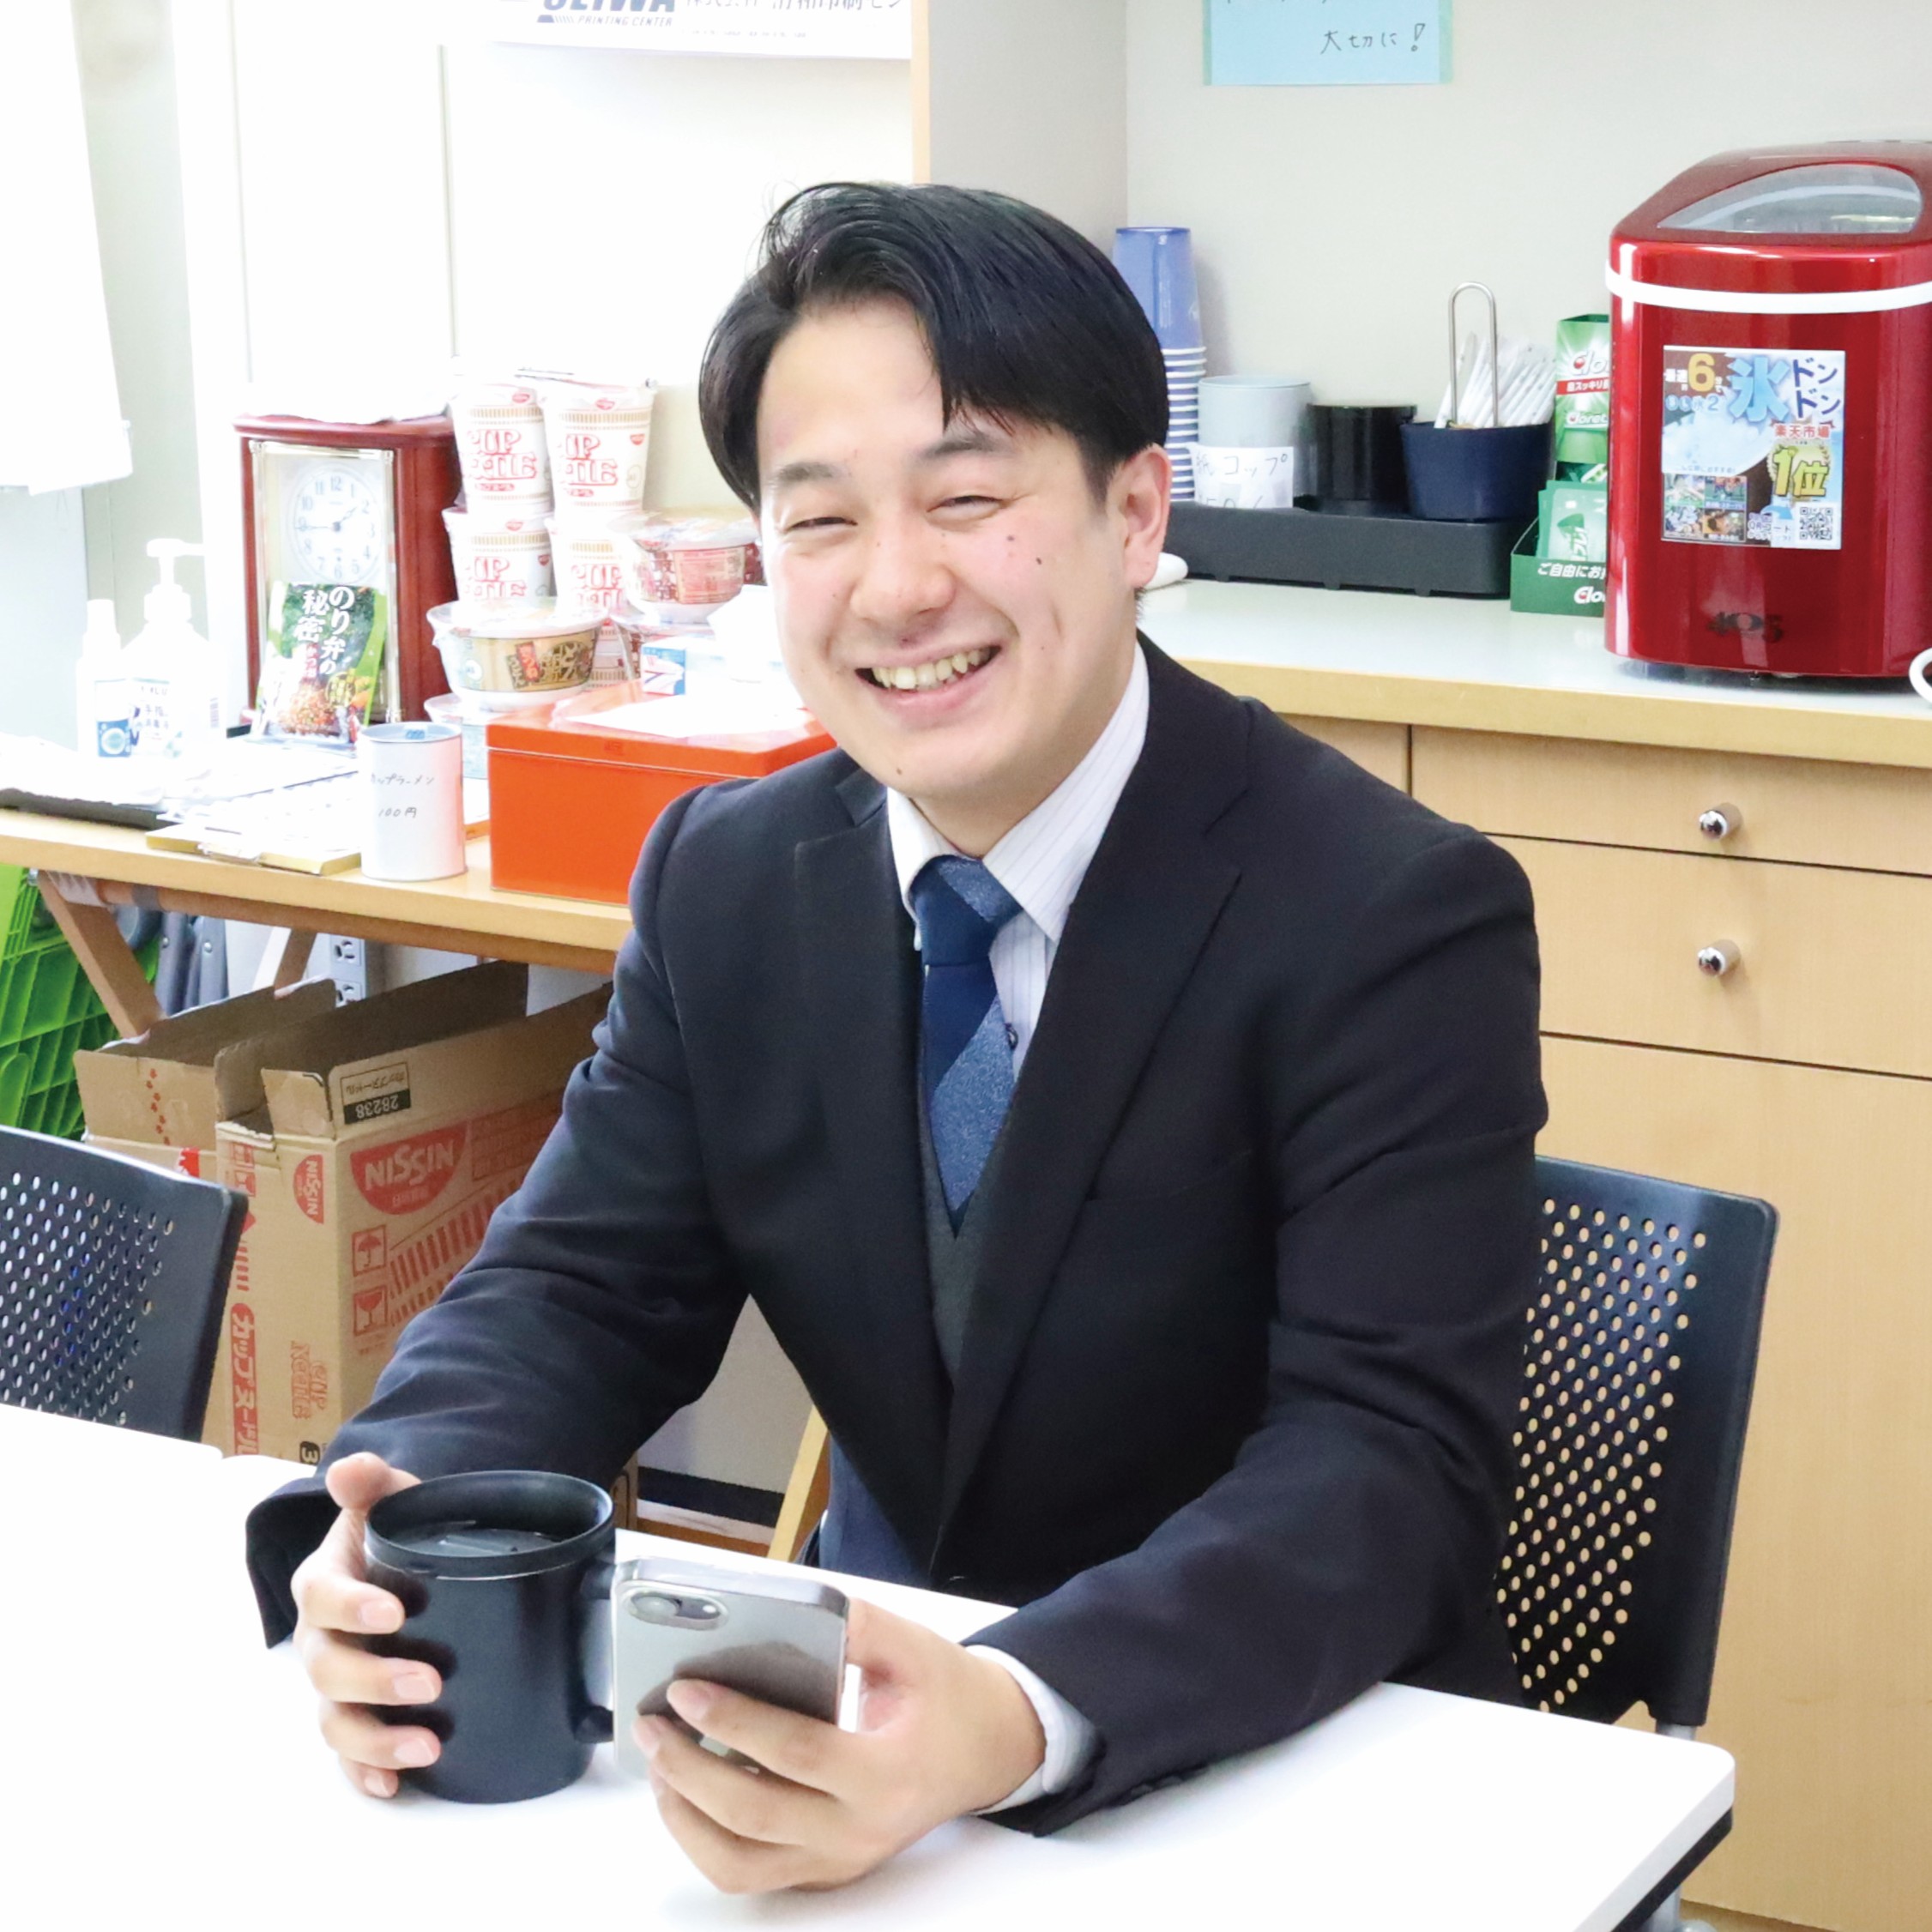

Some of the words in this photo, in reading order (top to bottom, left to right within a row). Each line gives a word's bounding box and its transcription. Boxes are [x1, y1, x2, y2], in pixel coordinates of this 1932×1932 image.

[577, 15, 629, 27] PRINTING
[631, 16, 673, 27] CENTER
[1727, 356, 1791, 422] 氷
[293, 589, 330, 643] 秘密
[319, 586, 355, 675] のり弁の
[378, 807, 417, 818] 100円
[355, 1094, 400, 1120] 28238
[305, 1160, 322, 1216] NISSIN
[365, 1140, 455, 1191] NISSIN
[232, 1313, 258, 1455] カップヌードル
